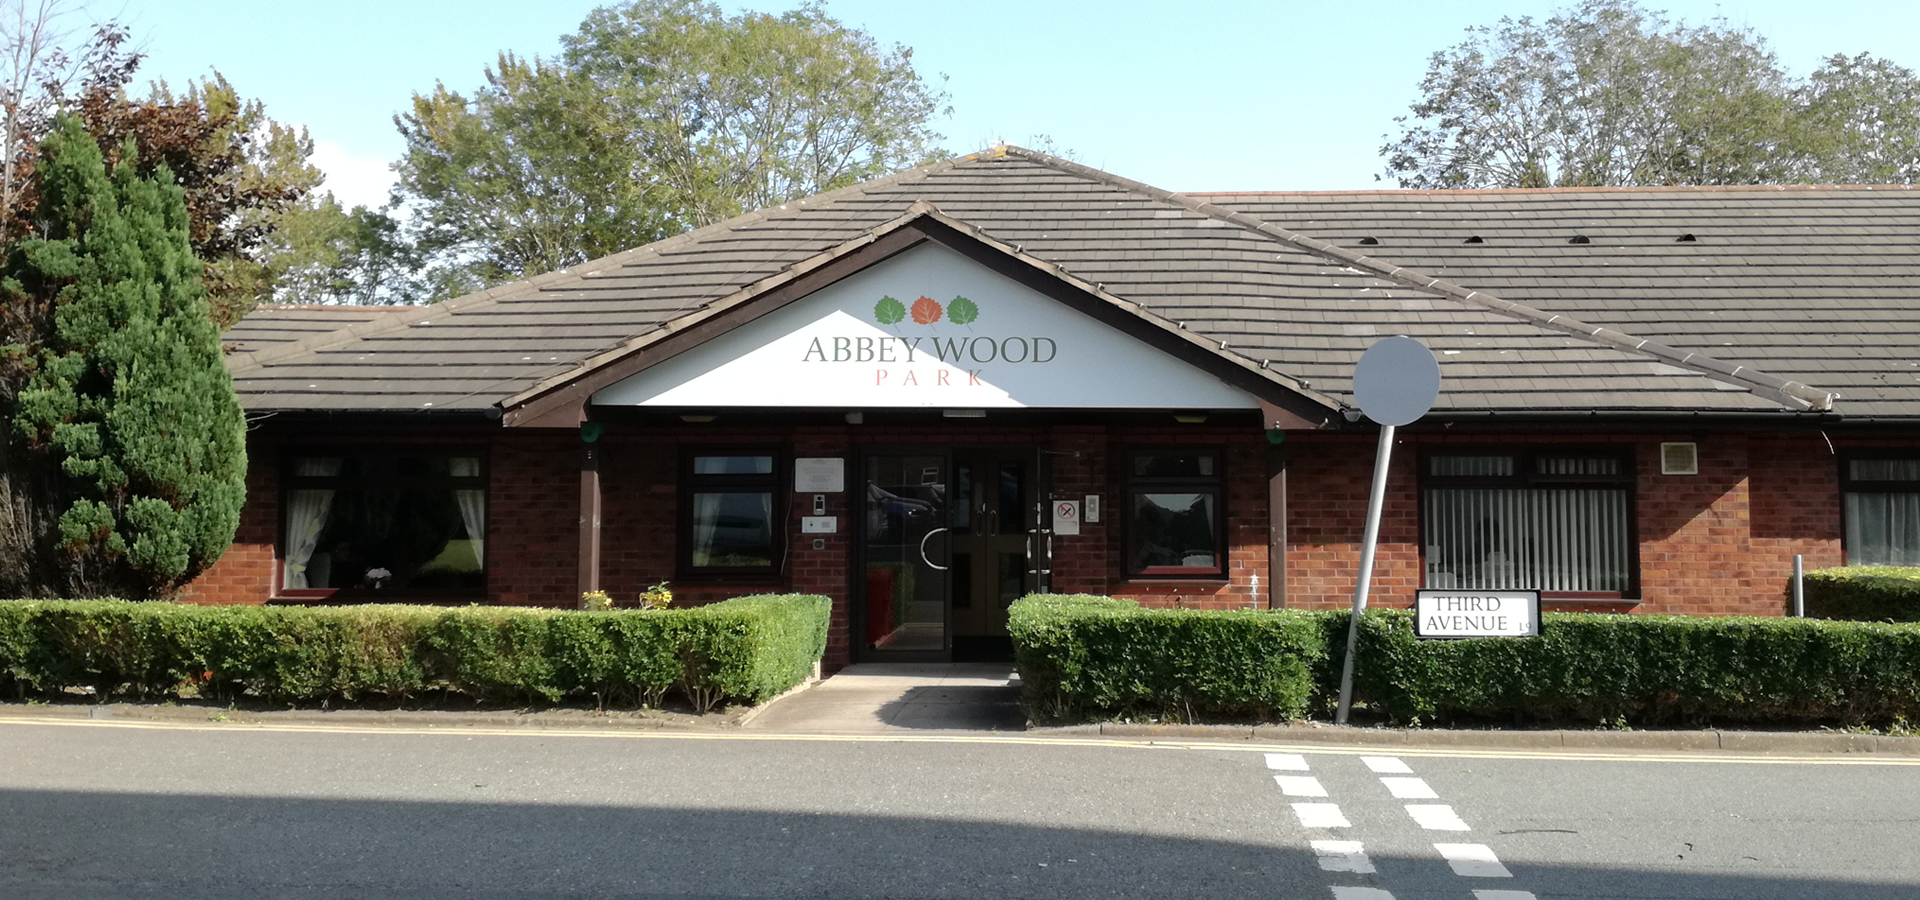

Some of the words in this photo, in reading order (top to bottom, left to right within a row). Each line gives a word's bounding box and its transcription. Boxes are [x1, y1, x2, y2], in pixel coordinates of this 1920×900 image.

[802, 336, 922, 362] ABBEY
[931, 336, 1057, 363] WOOD
[876, 369, 982, 386] PARK
[1433, 596, 1501, 611] THIRD
[1426, 616, 1508, 631] AVENUE
